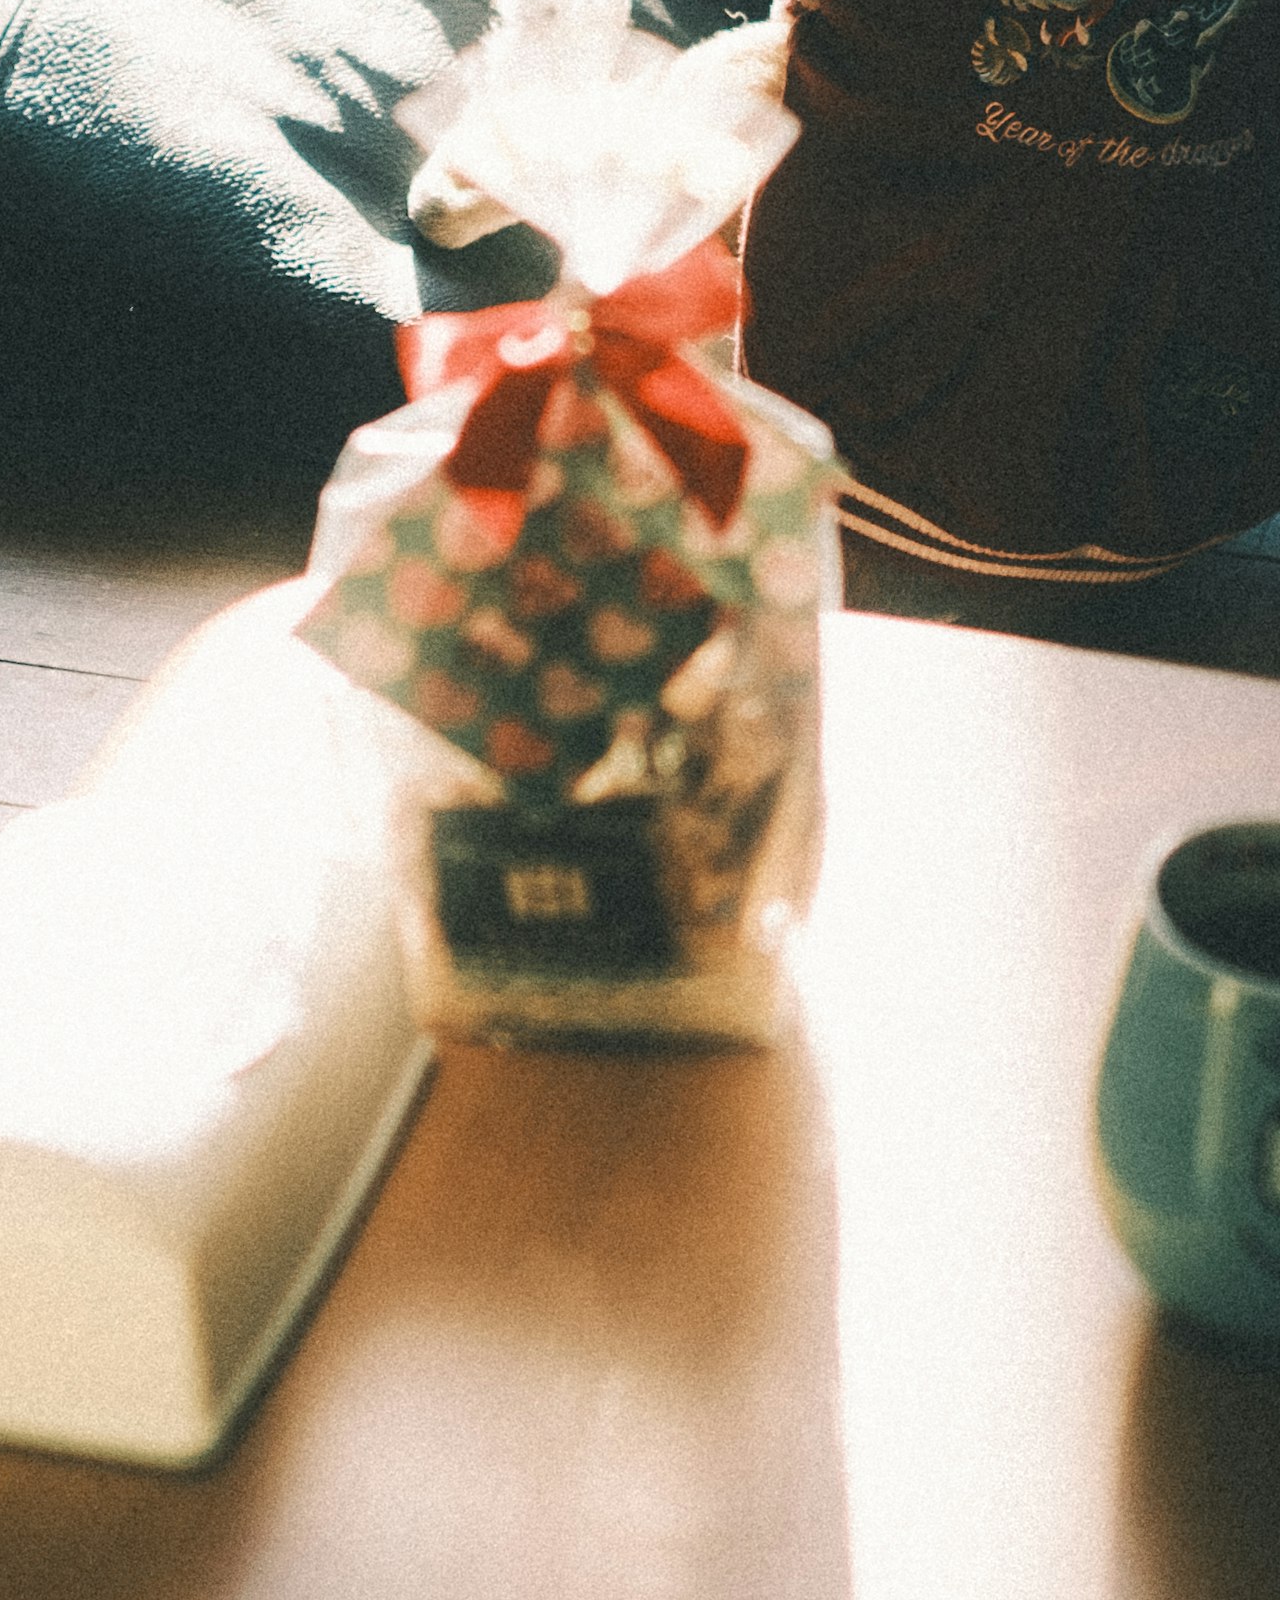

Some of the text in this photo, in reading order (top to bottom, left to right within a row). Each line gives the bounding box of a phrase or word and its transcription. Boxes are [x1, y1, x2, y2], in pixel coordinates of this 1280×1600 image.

[976, 101, 1055, 150] Year
[1057, 135, 1094, 167] of
[1098, 137, 1154, 168] the
